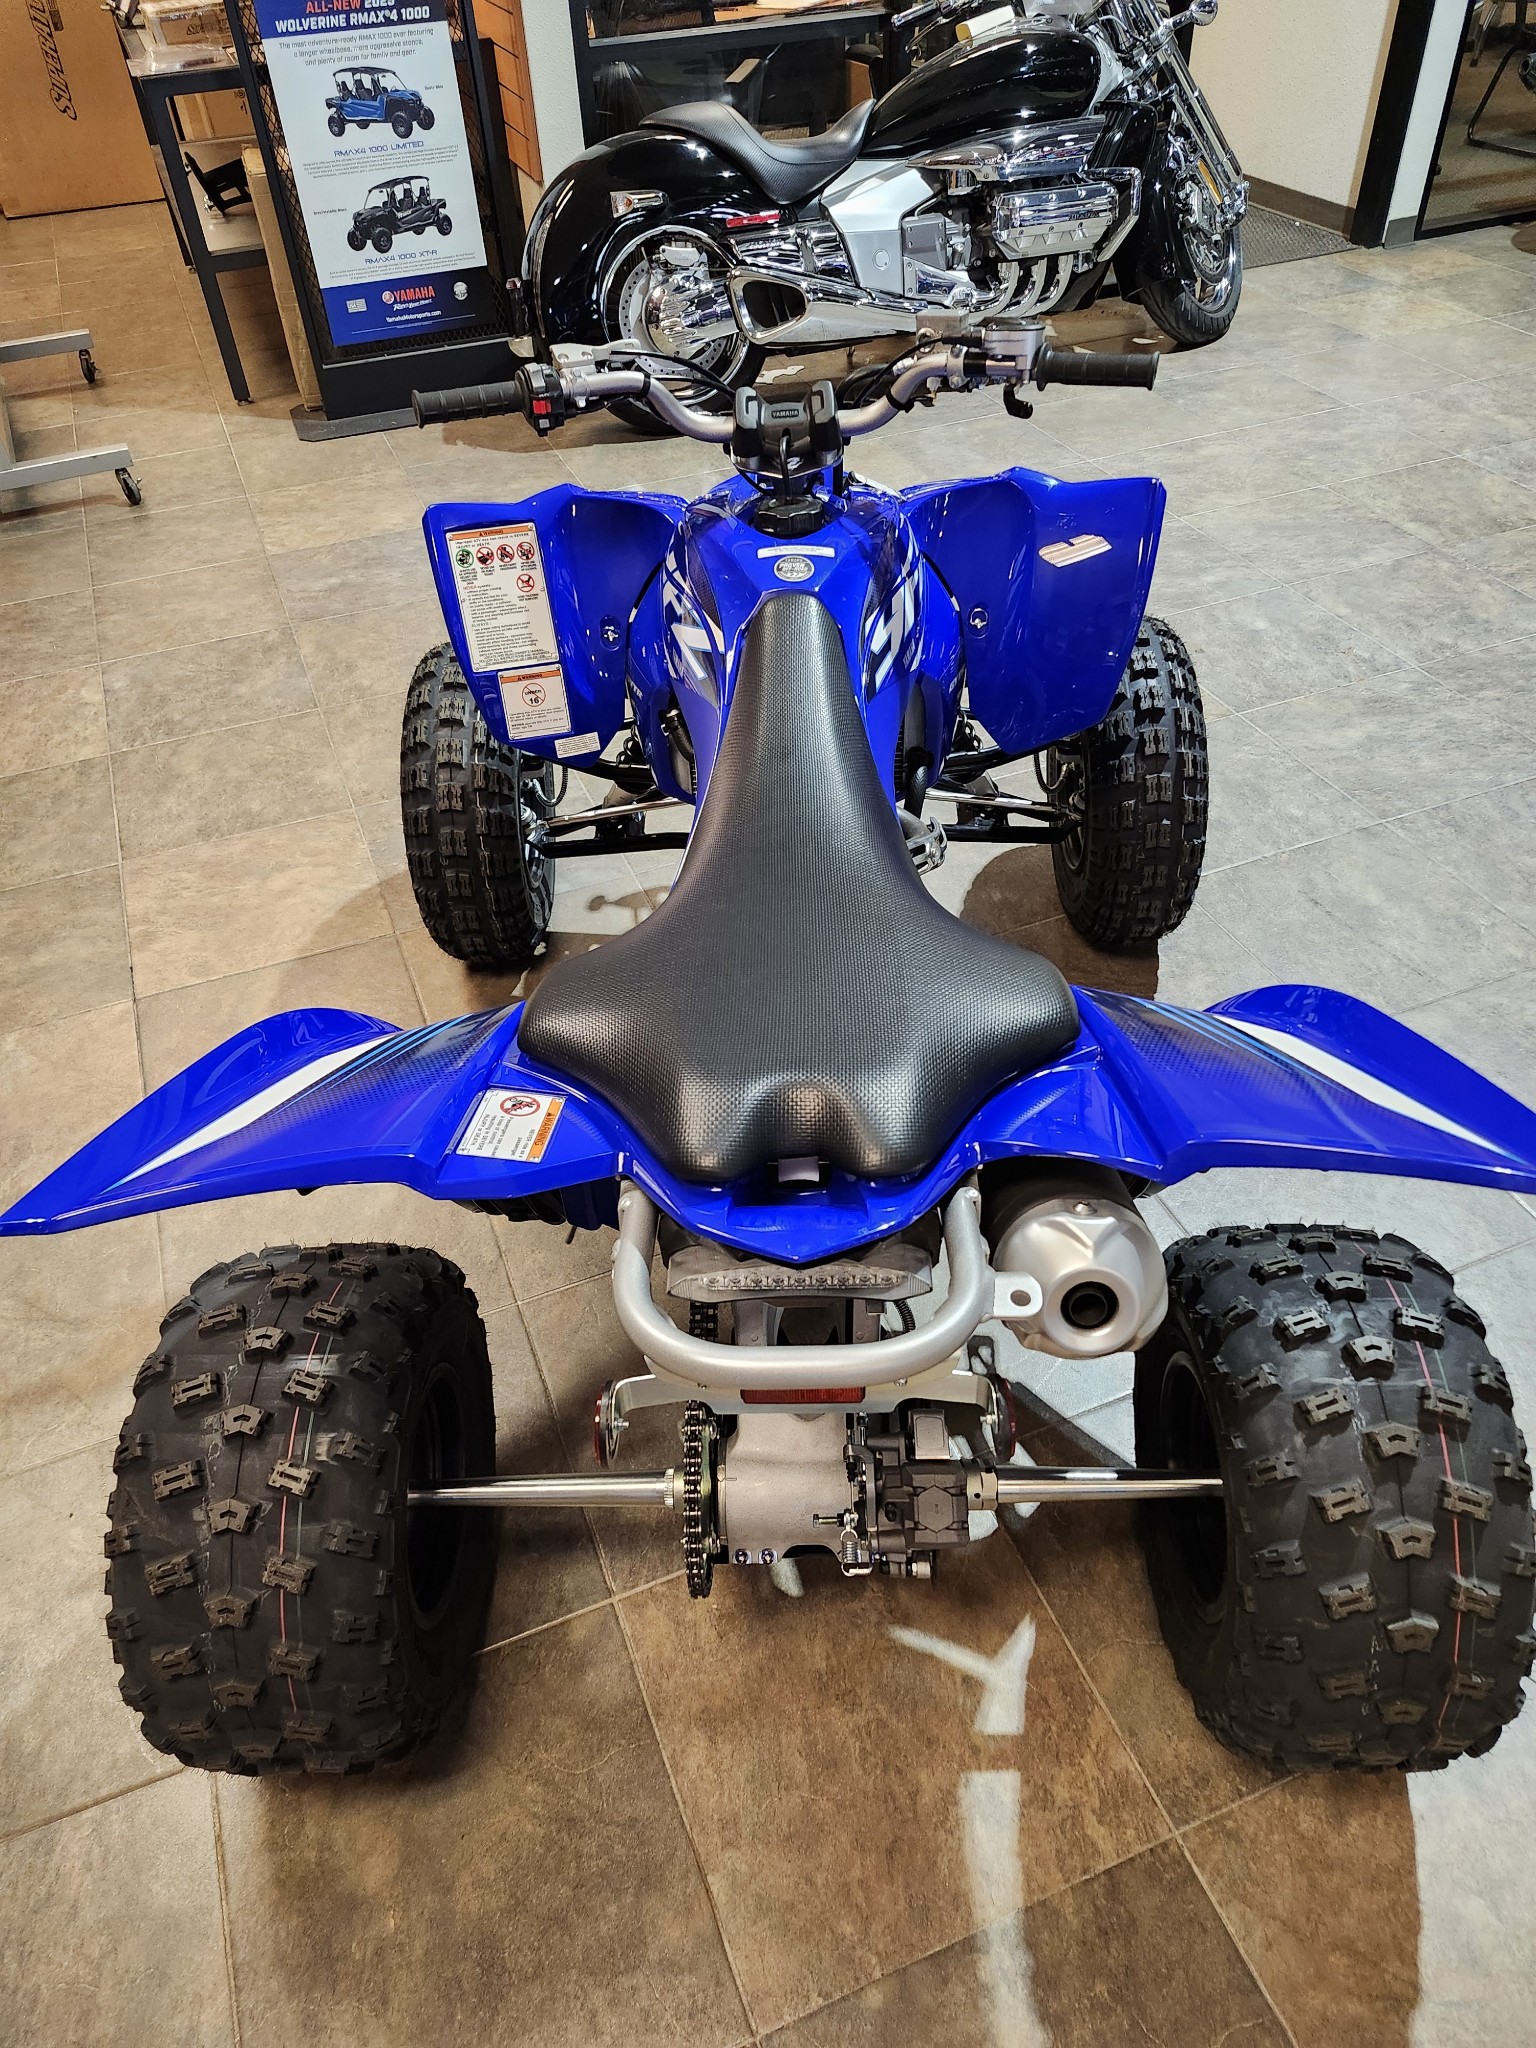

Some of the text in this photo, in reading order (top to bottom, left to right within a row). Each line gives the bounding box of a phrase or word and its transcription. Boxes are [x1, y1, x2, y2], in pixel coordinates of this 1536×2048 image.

[306, 0, 361, 13] ALL-NEW
[276, 15, 347, 33] WOLVERINE
[400, 5, 430, 20] 1000
[358, 34, 377, 42] RMAX
[378, 32, 392, 40] 1000
[407, 28, 434, 38] featuring
[299, 49, 318, 58] longer
[318, 57, 335, 66] plenty
[361, 53, 369, 61] for
[390, 50, 401, 58] and
[334, 141, 424, 157] RMAX4 1000 LIMITED
[365, 255, 395, 265] RMAX4
[419, 250, 438, 258] XT-R
[394, 286, 435, 302] YAMAHA
[386, 310, 441, 323] YamahaMotorsports.com
[772, 410, 799, 418] YAMAHA
[500, 1117, 514, 1137] Passengers
[535, 1114, 556, 1146] WARNING
[526, 1129, 535, 1142] NEVER
